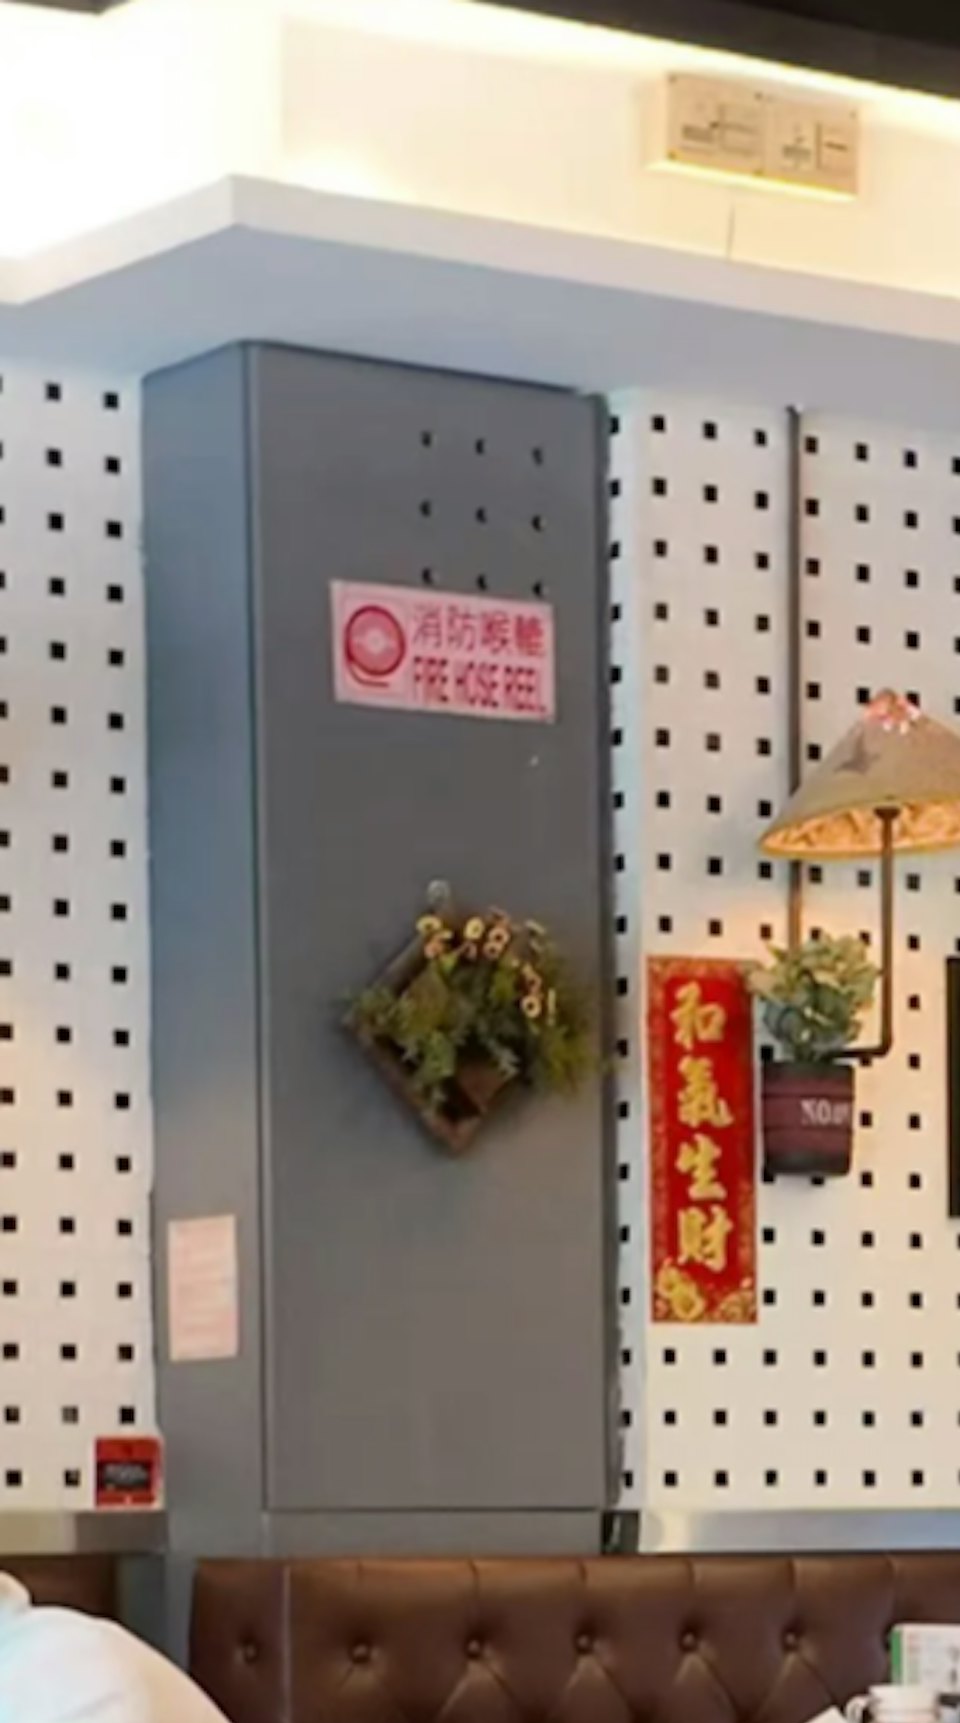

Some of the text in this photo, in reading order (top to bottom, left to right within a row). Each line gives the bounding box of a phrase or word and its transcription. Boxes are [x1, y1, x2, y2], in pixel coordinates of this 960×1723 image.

[413, 655, 547, 713] FIRE HOSE REEL
[670, 980, 735, 1272] 和氣生財
